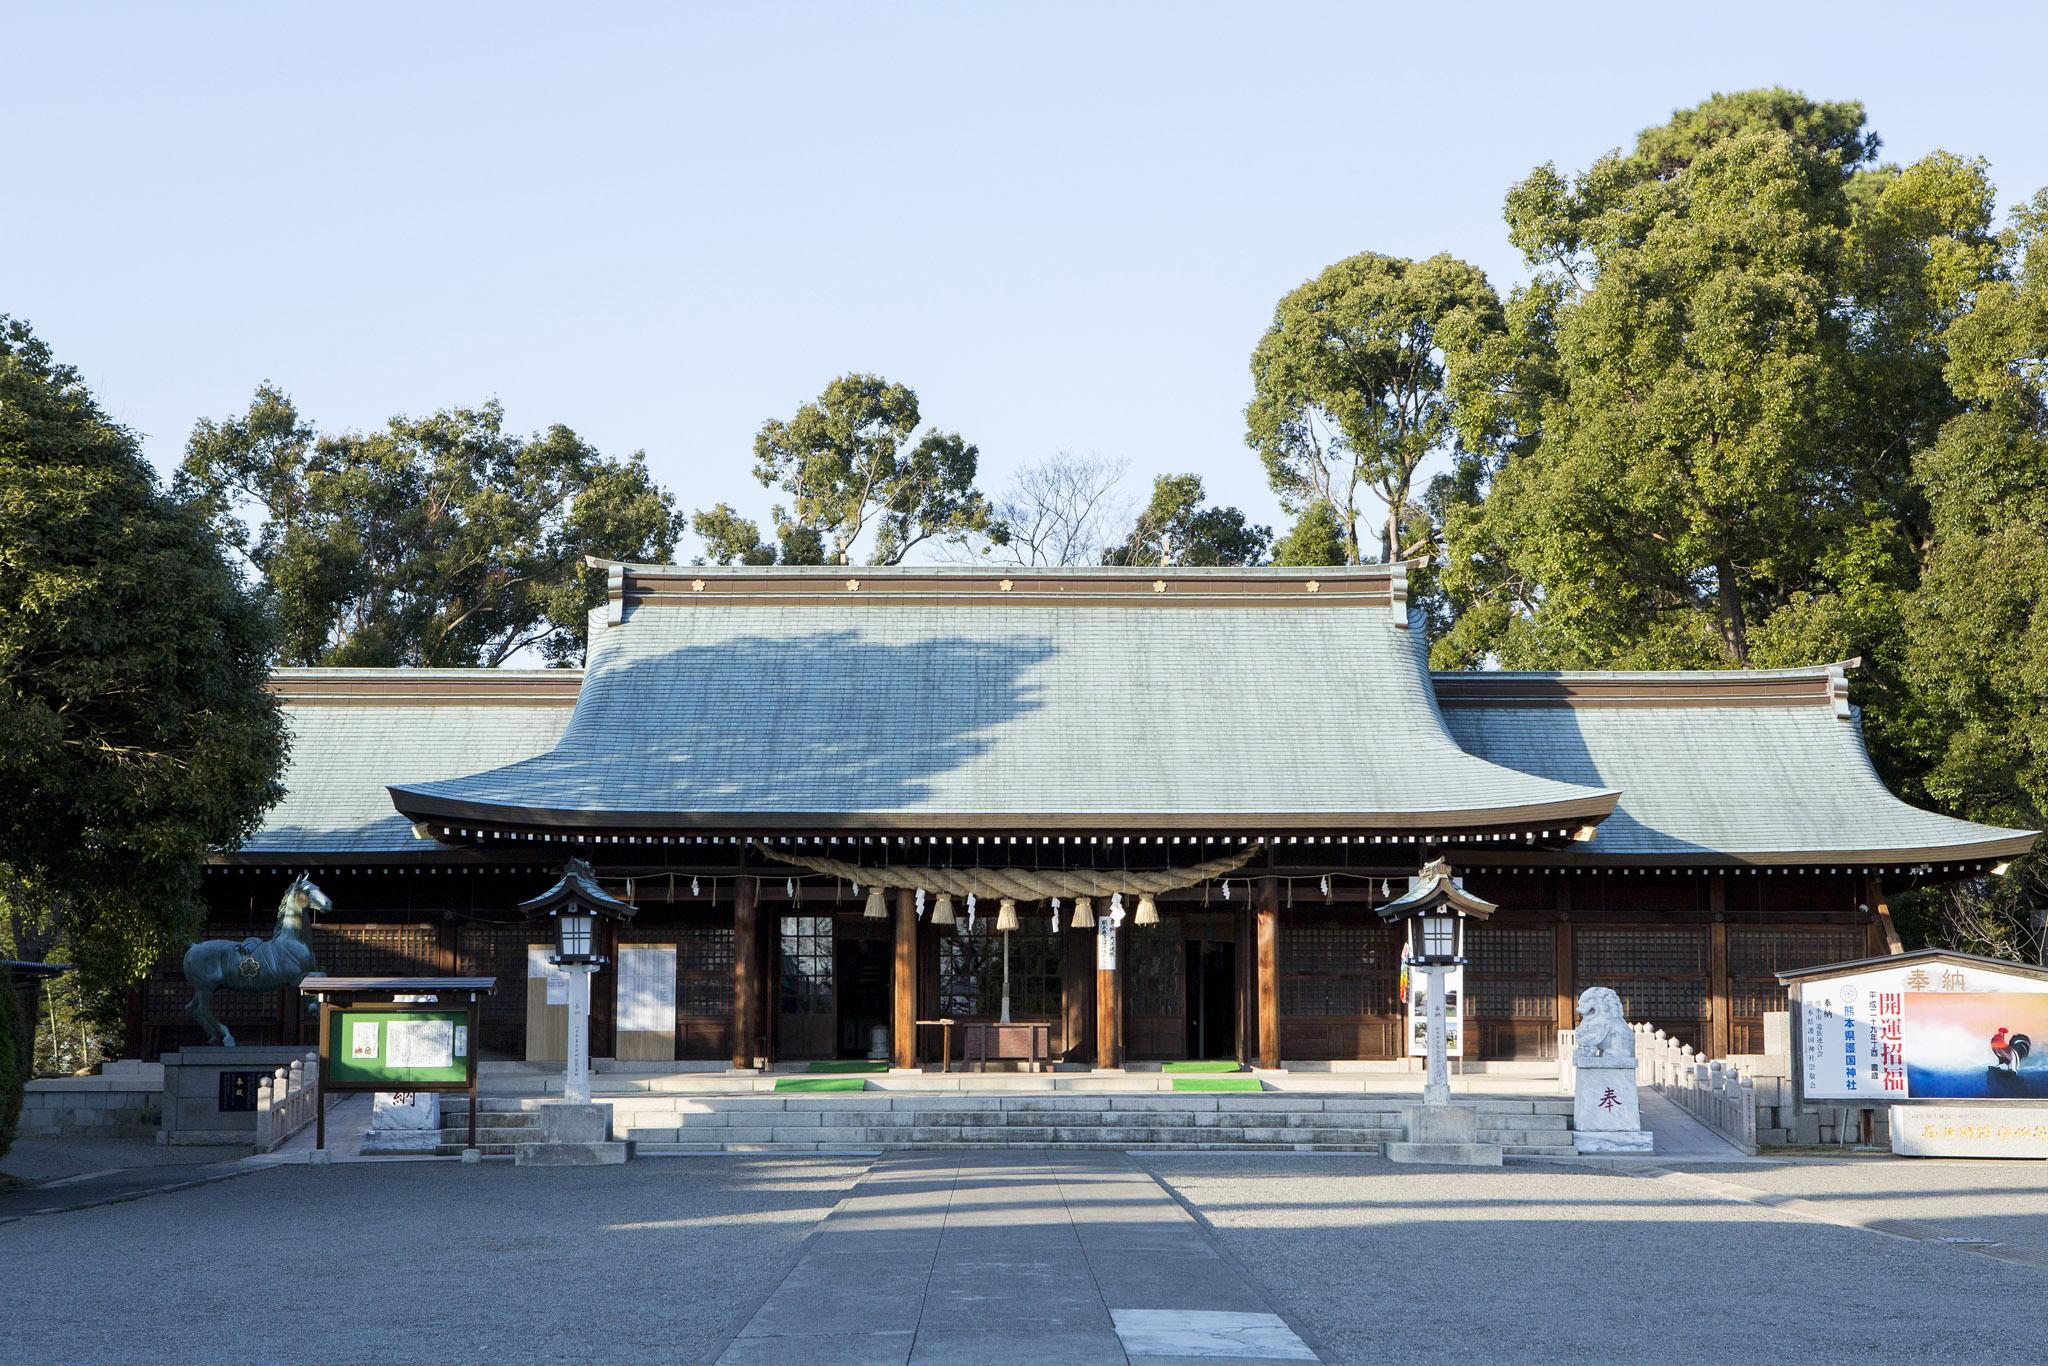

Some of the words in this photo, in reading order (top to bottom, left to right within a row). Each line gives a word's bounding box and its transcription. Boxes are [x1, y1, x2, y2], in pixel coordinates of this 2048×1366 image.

[1907, 969, 1966, 991] 奉納
[1844, 1005, 1857, 1091] 熊本県護国神社
[1879, 992, 1904, 1091] 開運招福
[1597, 1087, 1622, 1112] 奉
